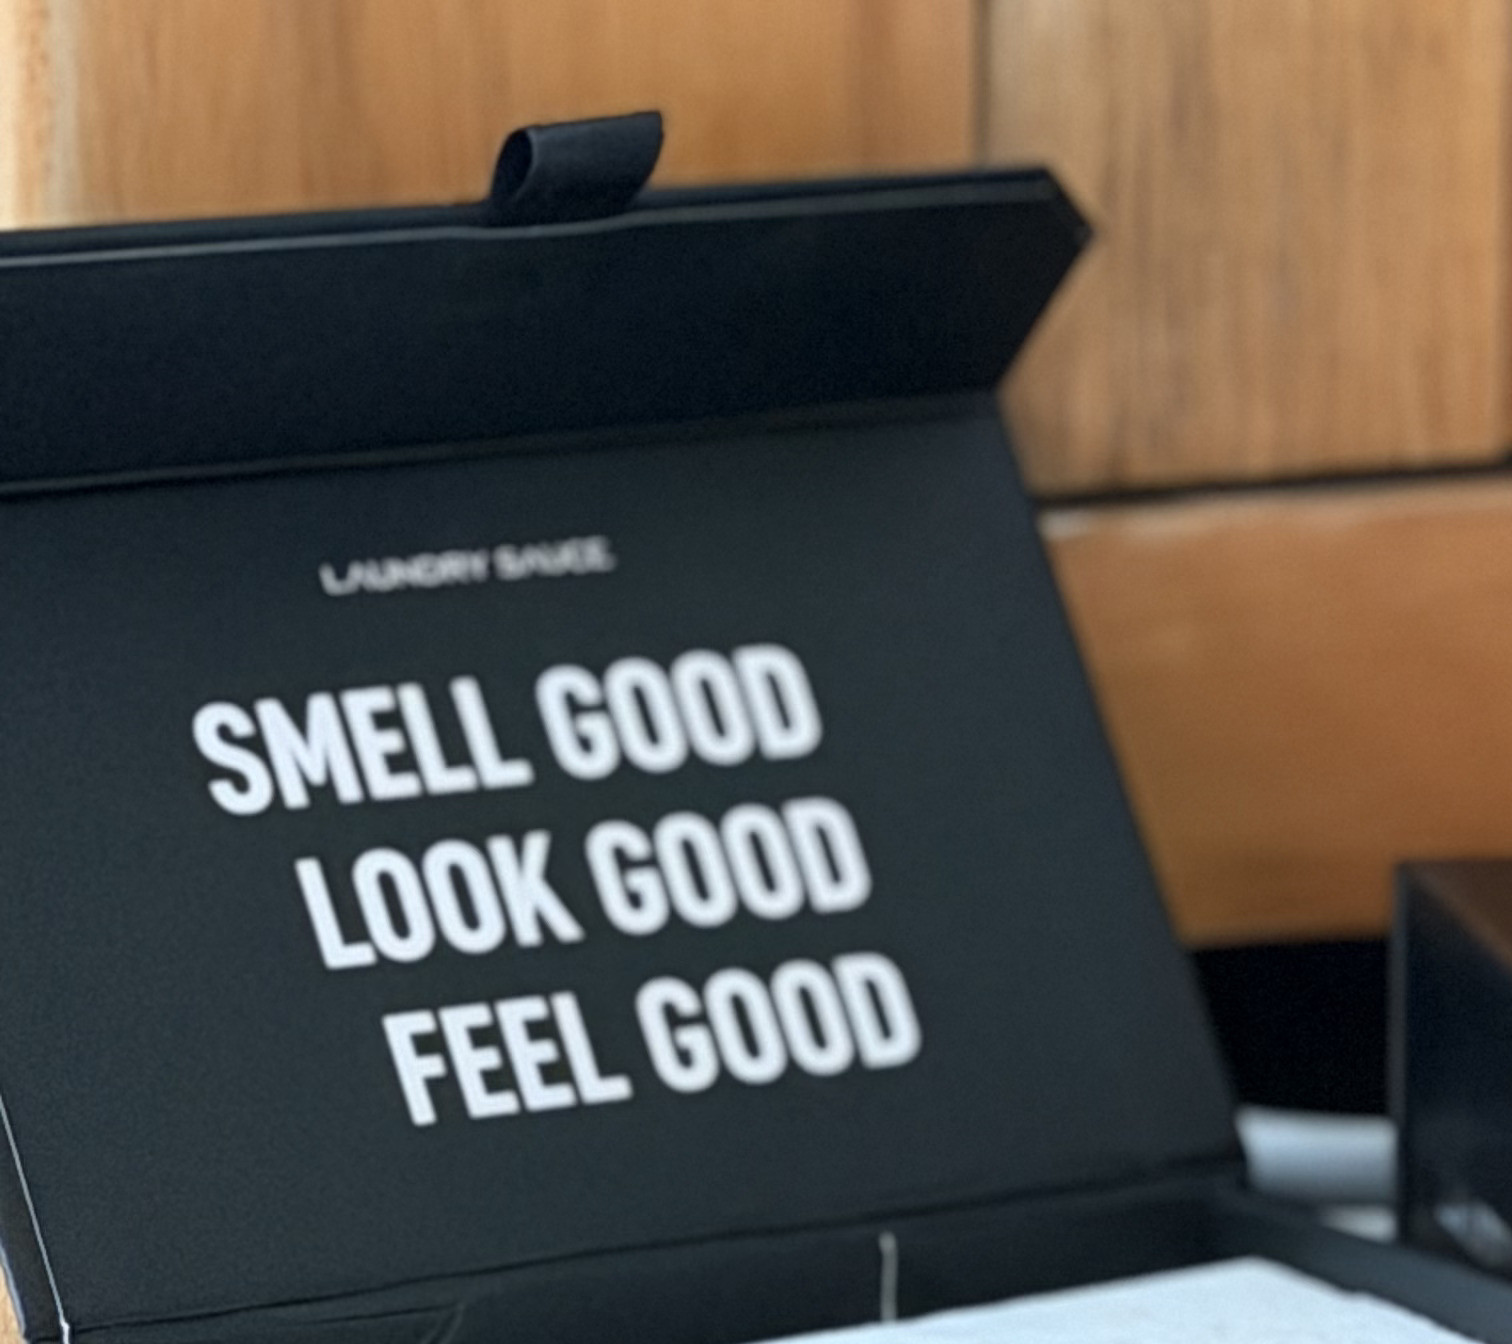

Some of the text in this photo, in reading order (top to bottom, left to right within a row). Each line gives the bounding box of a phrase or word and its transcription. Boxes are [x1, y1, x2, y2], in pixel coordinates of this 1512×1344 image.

[318, 548, 490, 596] LAUNDRY
[192, 643, 824, 816] SMELL GOOD
[295, 796, 873, 970] LOOK GOOD
[382, 951, 923, 1127] FEEL GOOD
